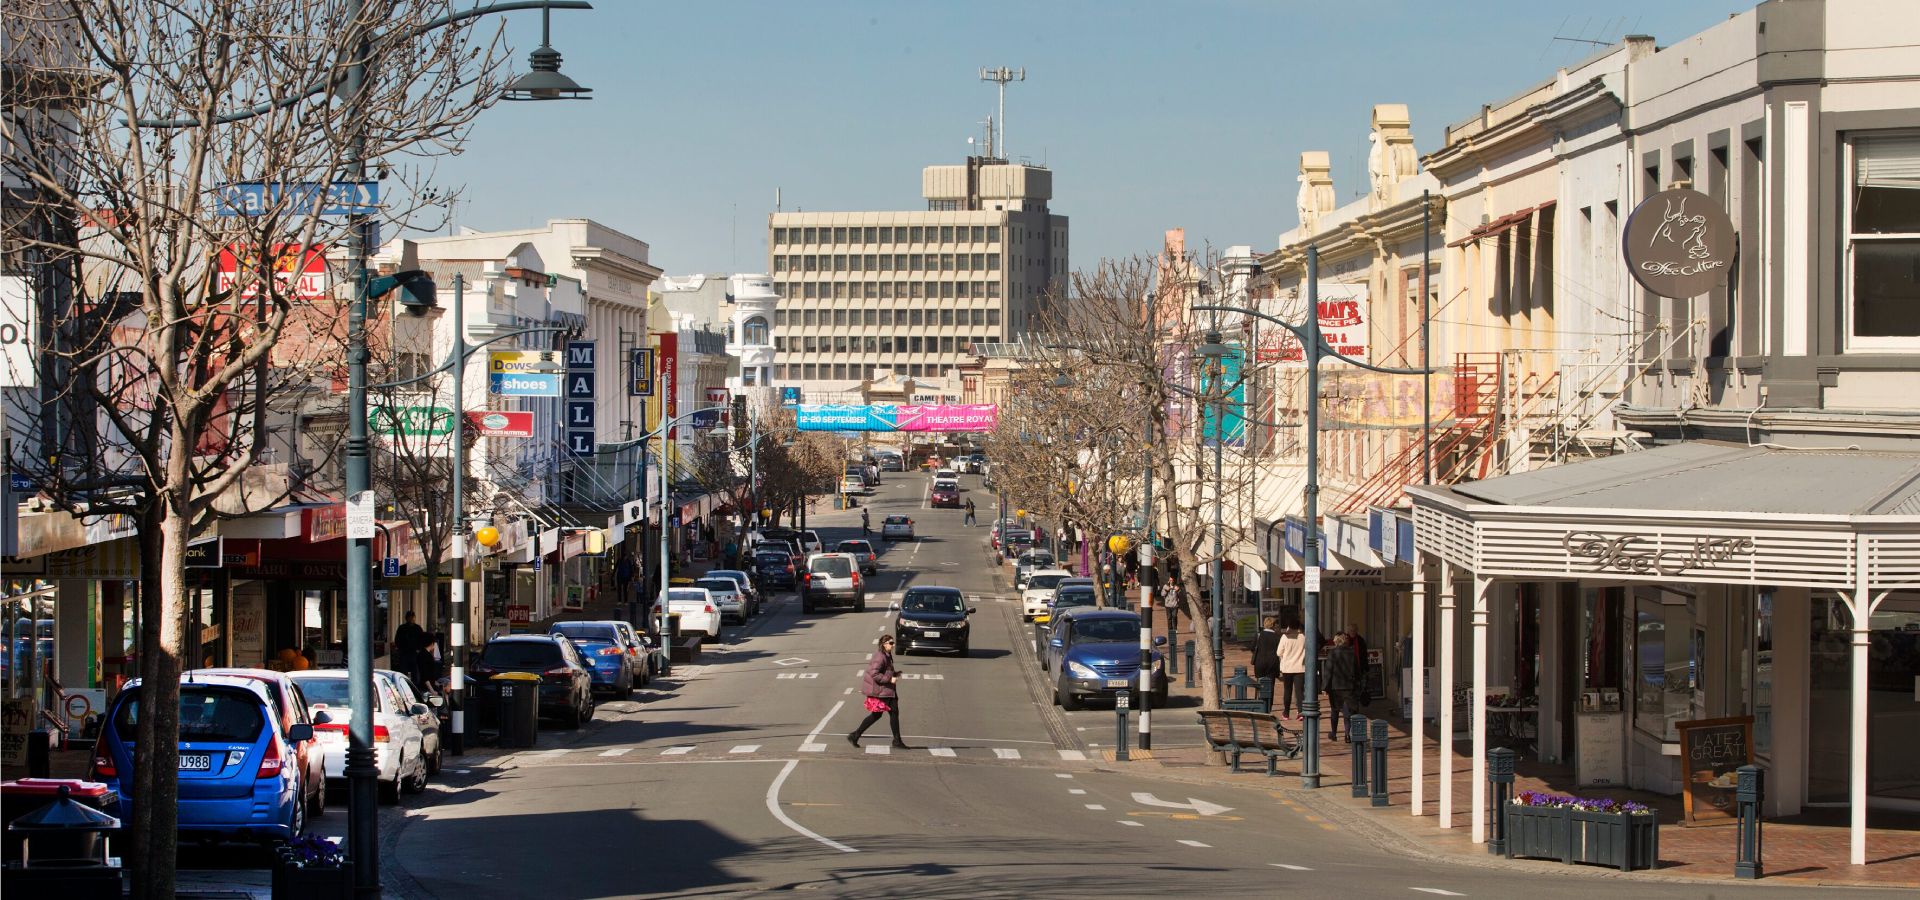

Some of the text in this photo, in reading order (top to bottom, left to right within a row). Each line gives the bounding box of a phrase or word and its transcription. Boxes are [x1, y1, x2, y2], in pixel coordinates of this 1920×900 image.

[325, 184, 350, 211] St
[1641, 259, 1725, 277] Coffee Culture
[1338, 345, 1365, 356] HOUSE
[503, 378, 547, 390] shoes
[570, 347, 593, 453] MALL
[823, 416, 867, 424] SEPTEMBER
[927, 415, 964, 424] THEATRE
[349, 516, 373, 525] CAMERA
[353, 526, 369, 535] AREA
[1562, 530, 1757, 576] Coffee Culture
[508, 609, 529, 620] OPEN
[1694, 731, 1743, 748] LATE?
[1690, 743, 1748, 761] GREAT!
[179, 756, 209, 768] U988
